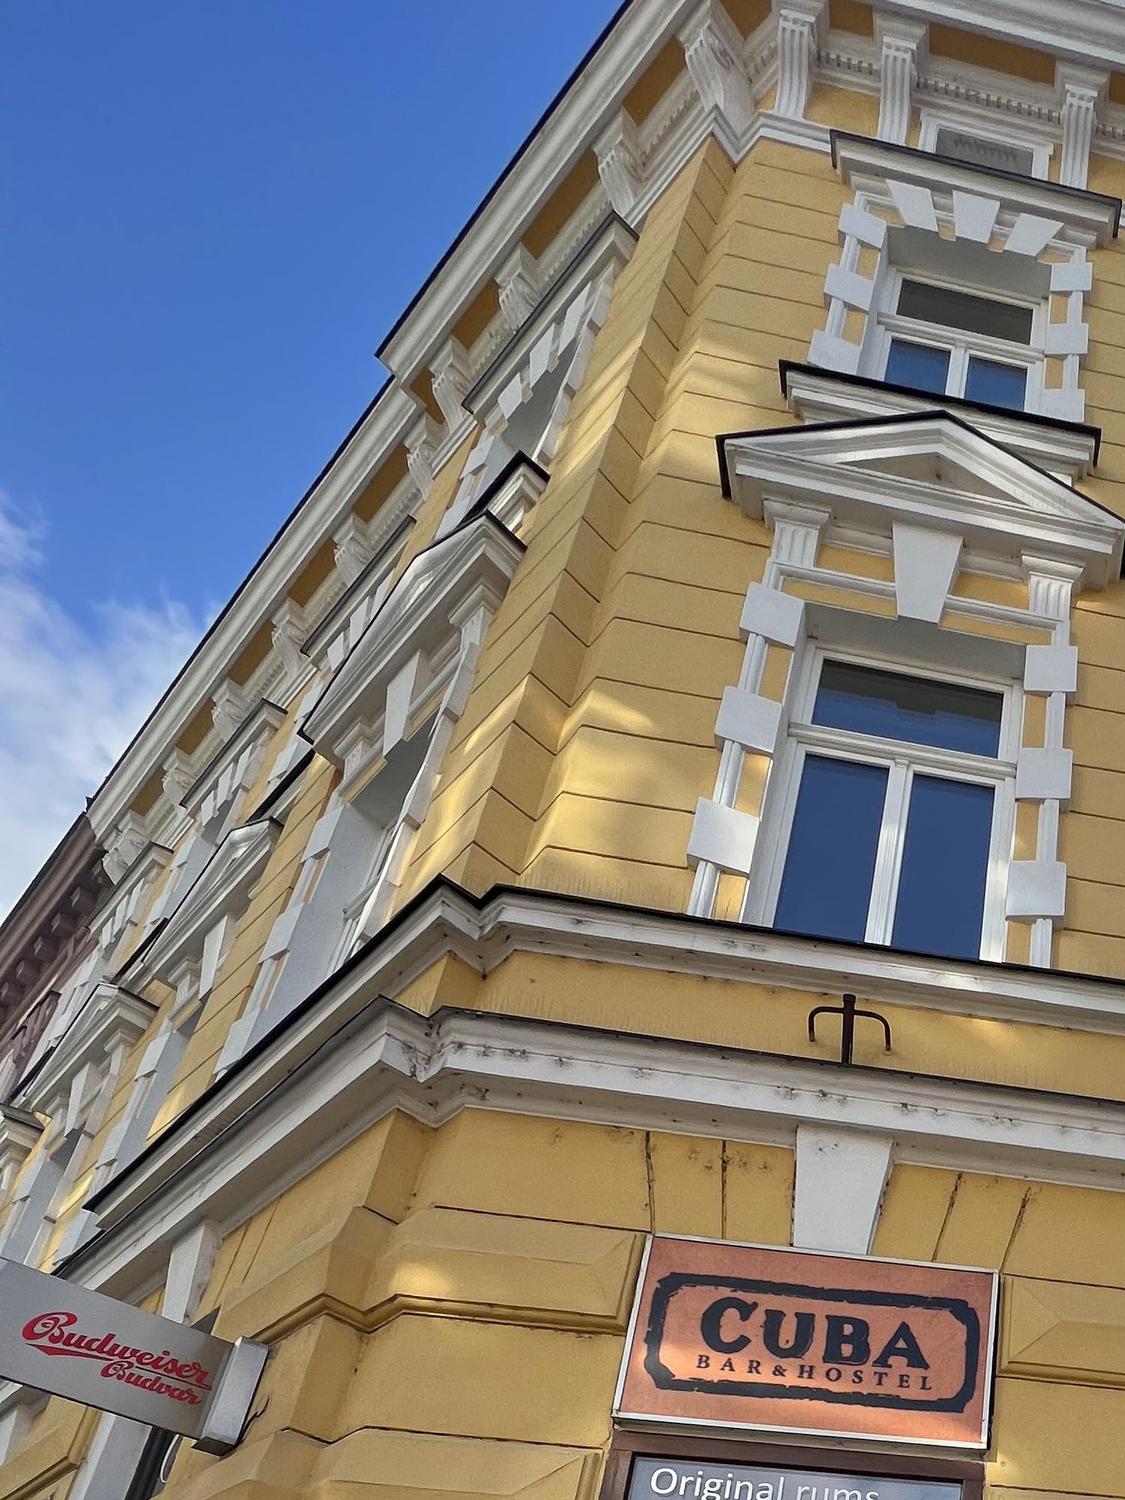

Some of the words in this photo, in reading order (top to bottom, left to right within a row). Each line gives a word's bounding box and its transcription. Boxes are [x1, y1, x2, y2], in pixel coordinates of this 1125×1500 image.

[22, 1312, 212, 1390] Budweiser
[700, 1297, 930, 1370] CUBA
[100, 1361, 201, 1404] Budvar
